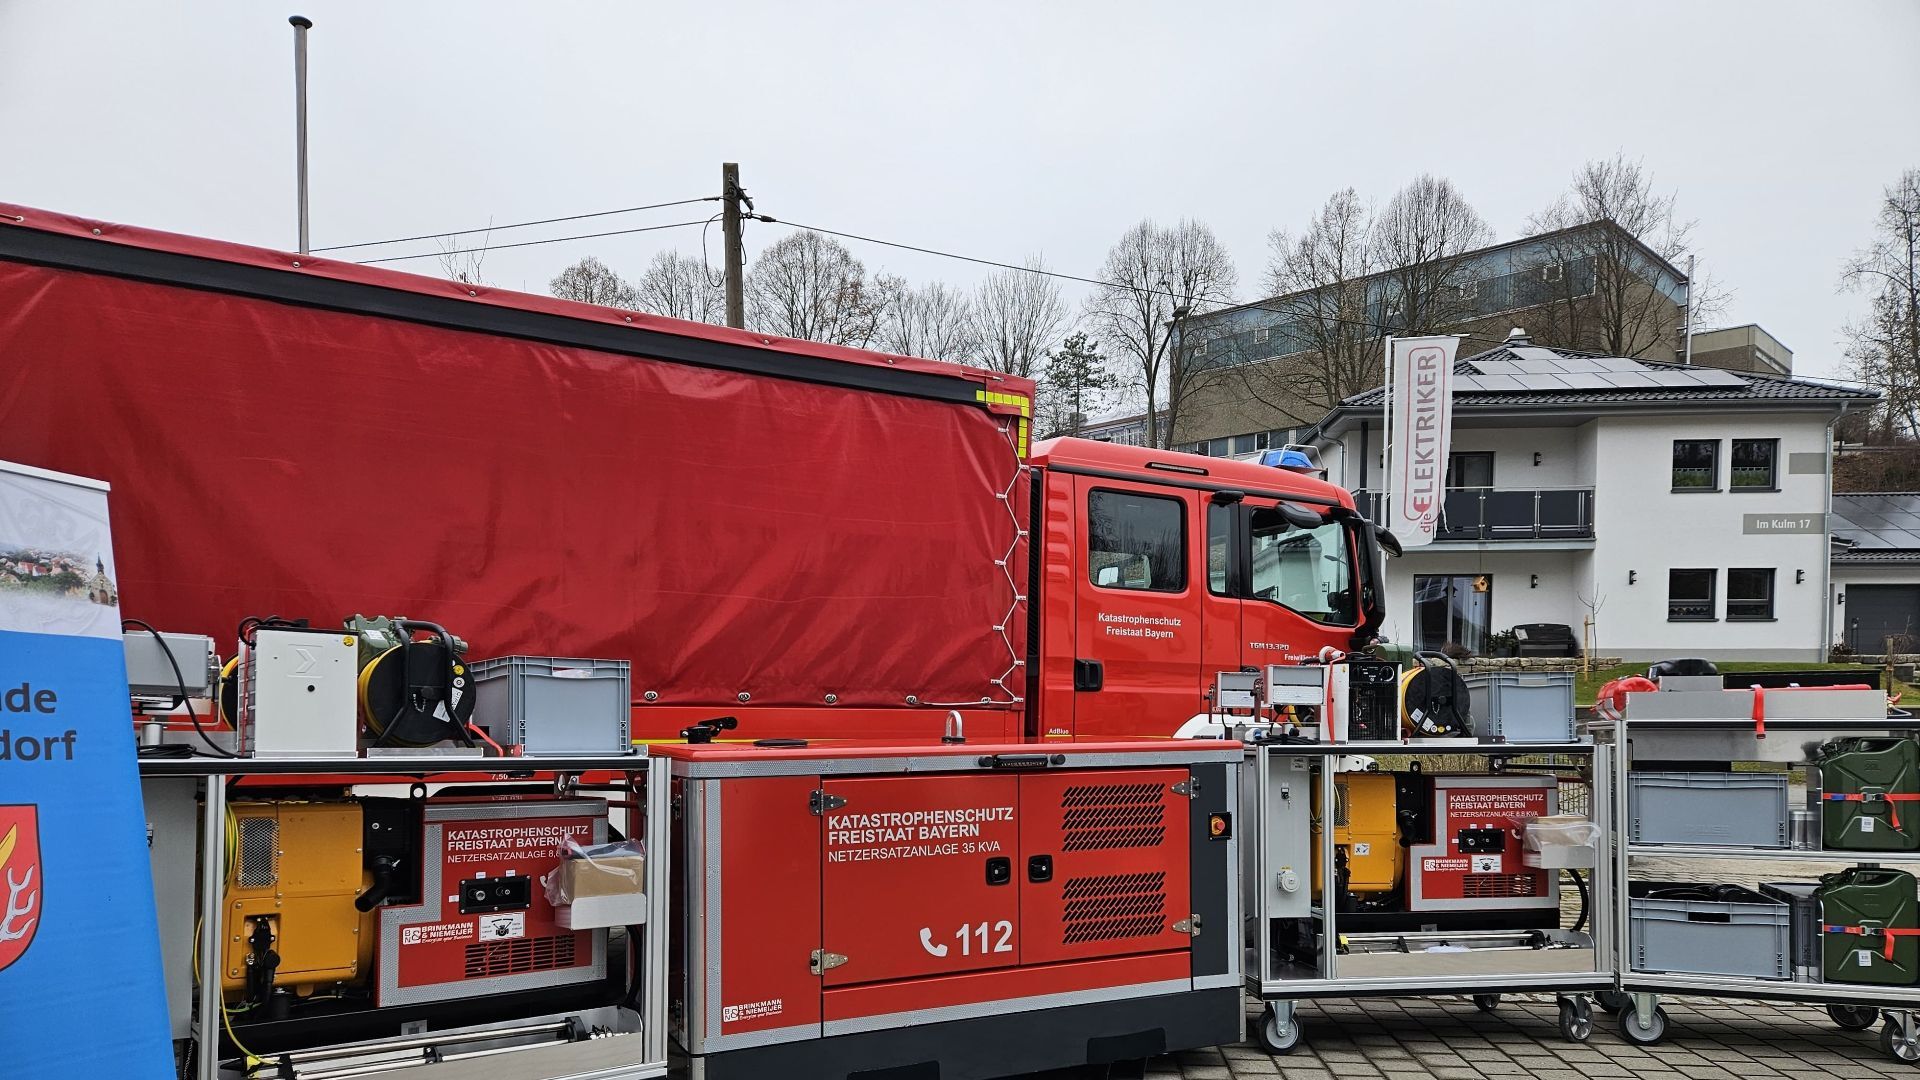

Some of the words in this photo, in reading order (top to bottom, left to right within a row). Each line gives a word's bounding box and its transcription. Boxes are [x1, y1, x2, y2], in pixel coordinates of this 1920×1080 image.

[1413, 353, 1437, 513] ELEKTRIKER
[1420, 513, 1432, 533] die
[1756, 519, 1769, 529] Im
[1771, 519, 1796, 529] Kulm
[1799, 519, 1811, 529] 17
[1098, 612, 1182, 626] Katastrophenschutz
[1106, 626, 1143, 637] Freistaat
[1145, 628, 1174, 640] Bayern
[1265, 643, 1290, 651] 13.320
[0, 682, 57, 714] de
[1450, 794, 1544, 802] KATASTROPHENSCHUTZ
[1450, 802, 1492, 810] FREISTAAT
[1494, 801, 1526, 809] BAYERN
[828, 807, 1014, 830] KATASTROPHENSCHUTZ
[448, 825, 589, 841] KATASTROPHENSCHUTZ
[828, 827, 914, 846] FREISTAAT
[919, 823, 980, 840] BAYERN
[448, 838, 513, 851] FREISTAAT
[516, 836, 562, 848] BAYERN
[447, 851, 546, 864] NETZERSATZANLAGE
[828, 844, 959, 863] NETZERSATZANLAGE
[962, 843, 975, 854] 35
[978, 841, 1000, 853] KVA
[421, 922, 473, 932] BRINKMANN
[430, 928, 473, 938] NIEMEIJER
[956, 920, 1013, 956] 112
[738, 998, 782, 1011] BRINKMANN
[745, 1004, 782, 1015] NIEMEIJER
